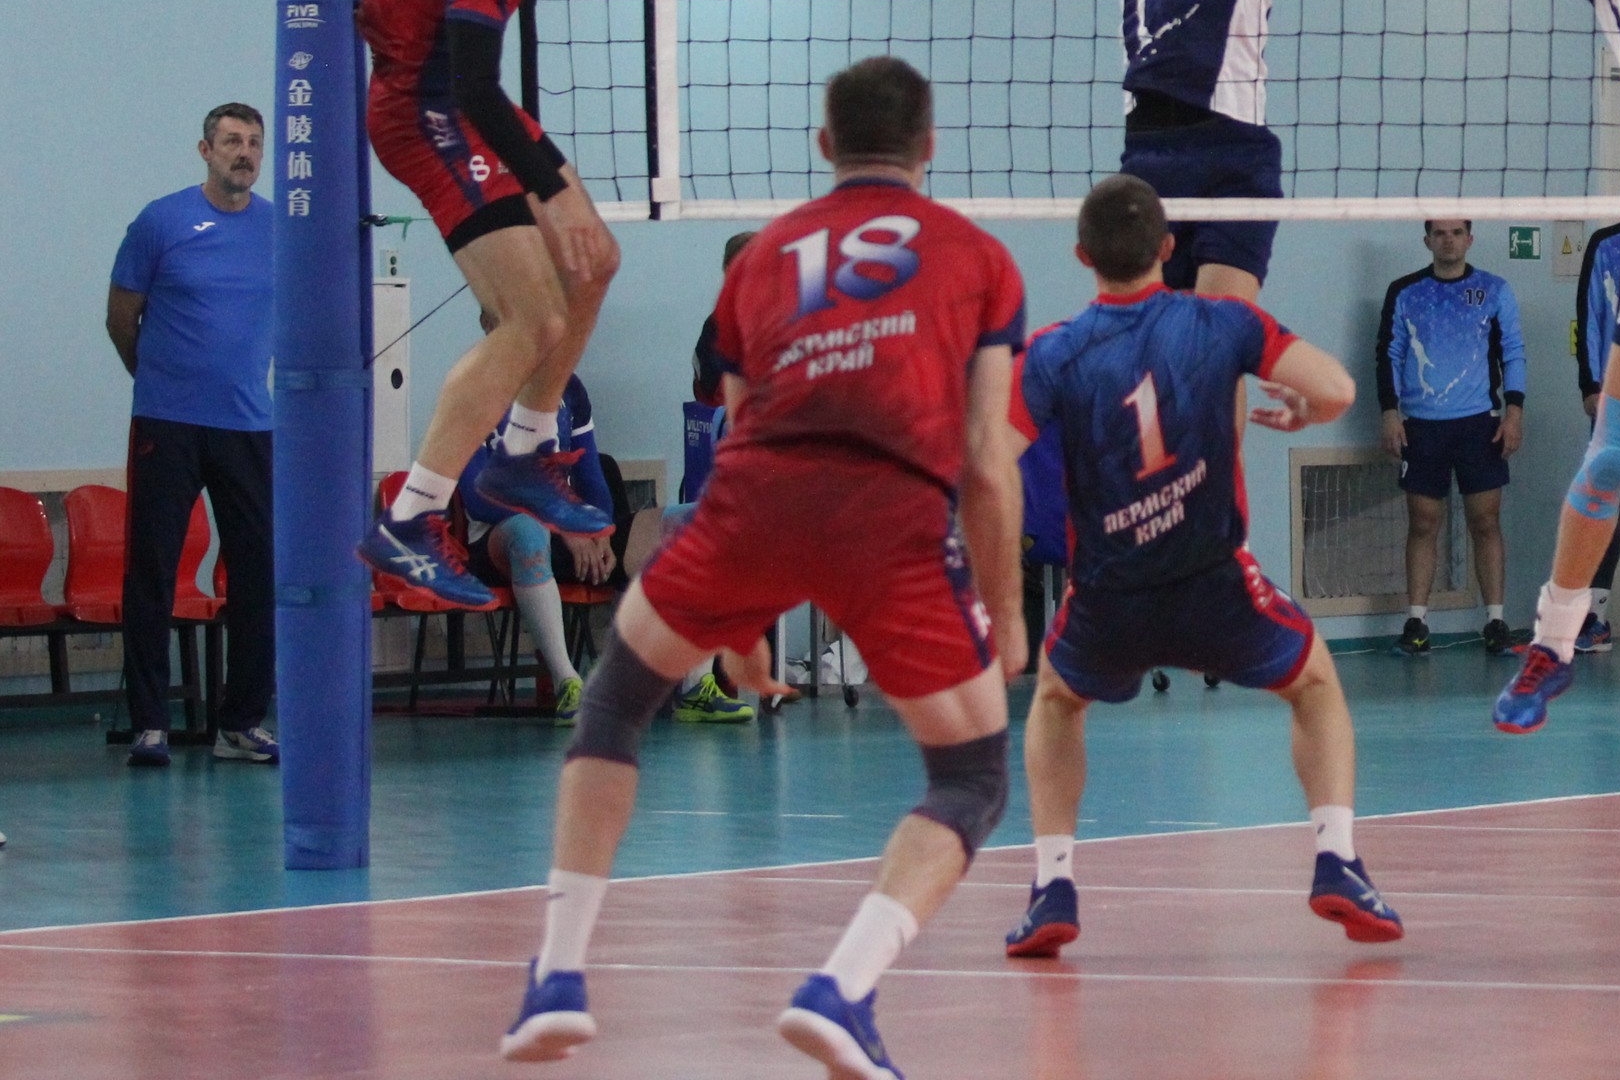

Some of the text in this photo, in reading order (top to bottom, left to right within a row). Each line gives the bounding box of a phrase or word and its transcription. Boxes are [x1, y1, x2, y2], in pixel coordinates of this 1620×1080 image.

[286, 4, 319, 18] FIVB
[286, 79, 313, 216] 金陵体育
[469, 154, 491, 182] 8
[780, 215, 921, 324] 18
[1464, 288, 1486, 307] 19
[1123, 370, 1177, 481] 1
[1104, 459, 1207, 534] ПЕРМСКИЙ
[1135, 500, 1185, 546] КРАЙ
